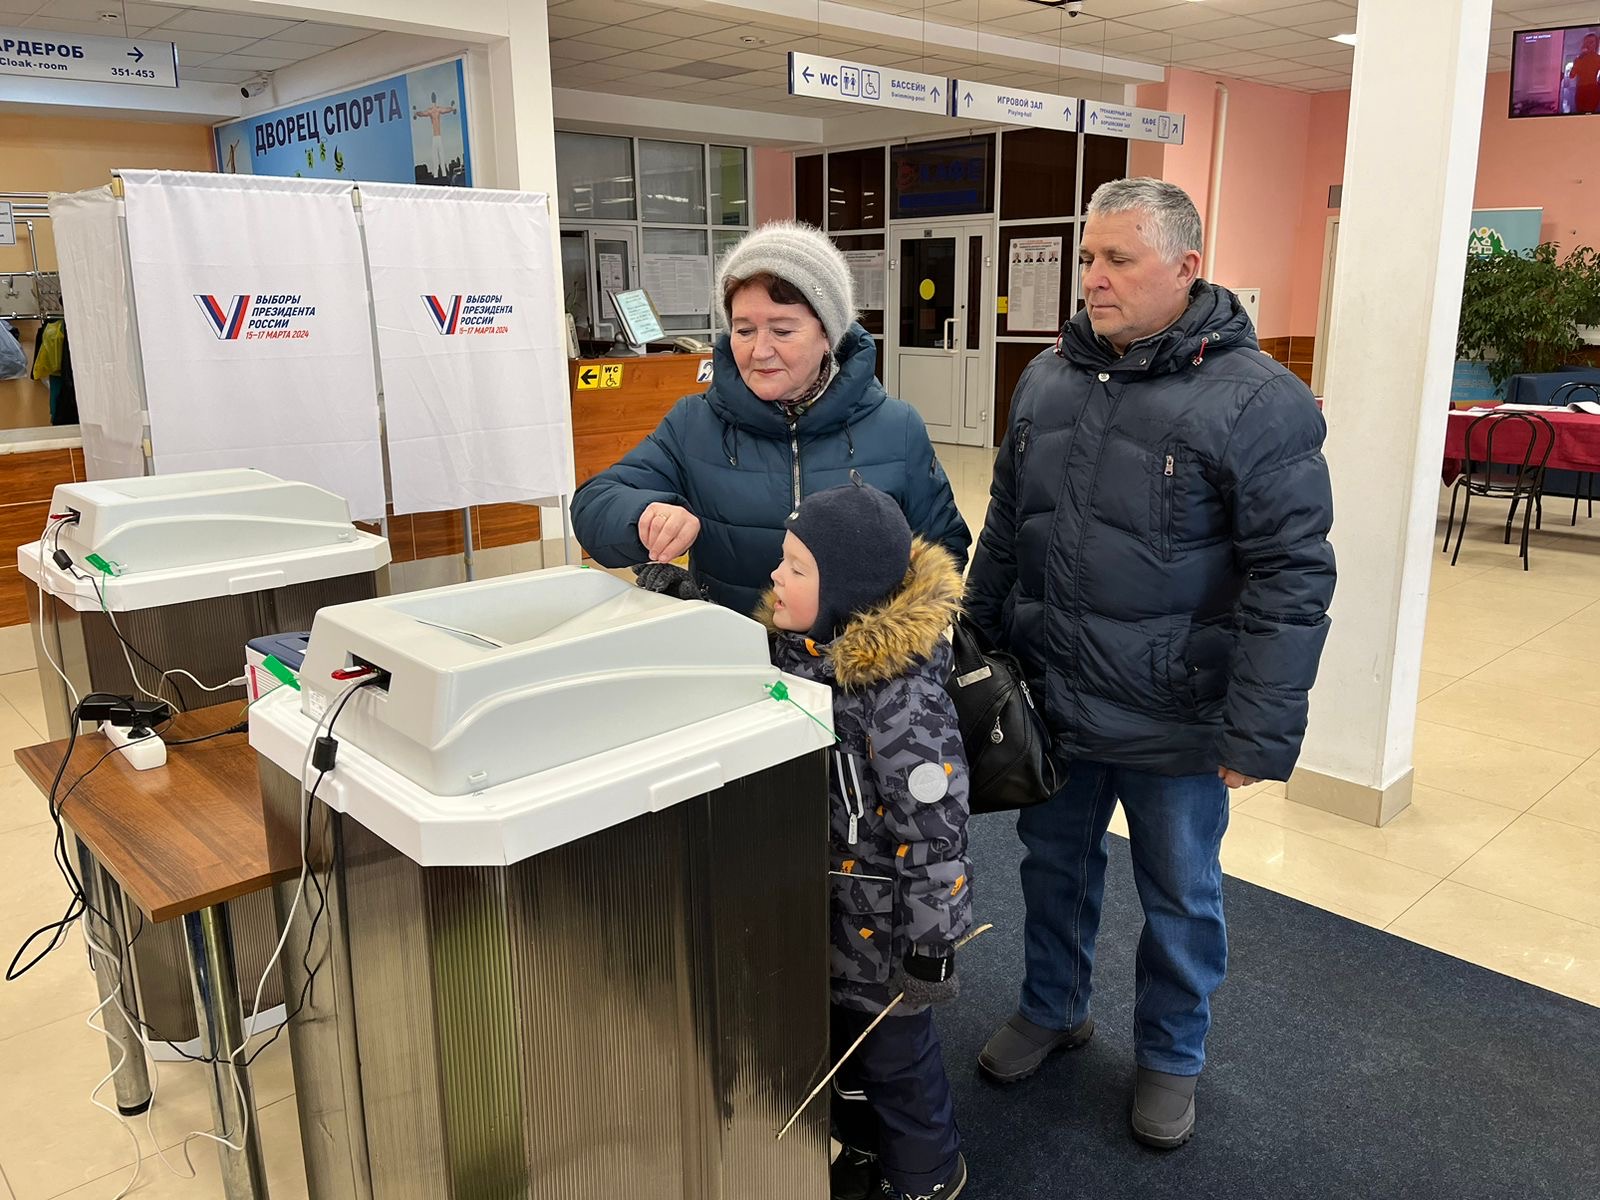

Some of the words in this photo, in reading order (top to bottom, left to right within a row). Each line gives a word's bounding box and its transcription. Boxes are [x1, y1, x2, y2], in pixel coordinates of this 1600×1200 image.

[0, 38, 85, 59] РДЕРОБ
[0, 57, 68, 72] Cloak-room
[111, 67, 155, 79] 351-453
[820, 73, 838, 87] WC
[891, 79, 926, 93] БАССЕЙН
[997, 95, 1029, 109] ИГРОВОЙ
[1030, 101, 1043, 110] ЗАЛ
[255, 110, 320, 157] ДВОРЕЦ
[323, 88, 402, 136] СПОРТА
[1142, 117, 1156, 126] КАФЕ
[255, 295, 301, 305] ВЫБОРЫ
[466, 294, 503, 304] ВЫБОРЫ
[252, 307, 316, 318] ПРЕЗИДЕНТА
[462, 305, 513, 315] ПРЕЗИДЕНТА
[248, 319, 290, 329] РОССИИ
[460, 316, 494, 325] РОССИИ
[266, 331, 291, 339] МАРТА
[292, 330, 309, 339] 2024
[474, 326, 495, 334] МАРТА
[495, 326, 509, 334] 2024
[604, 366, 618, 374] WC
